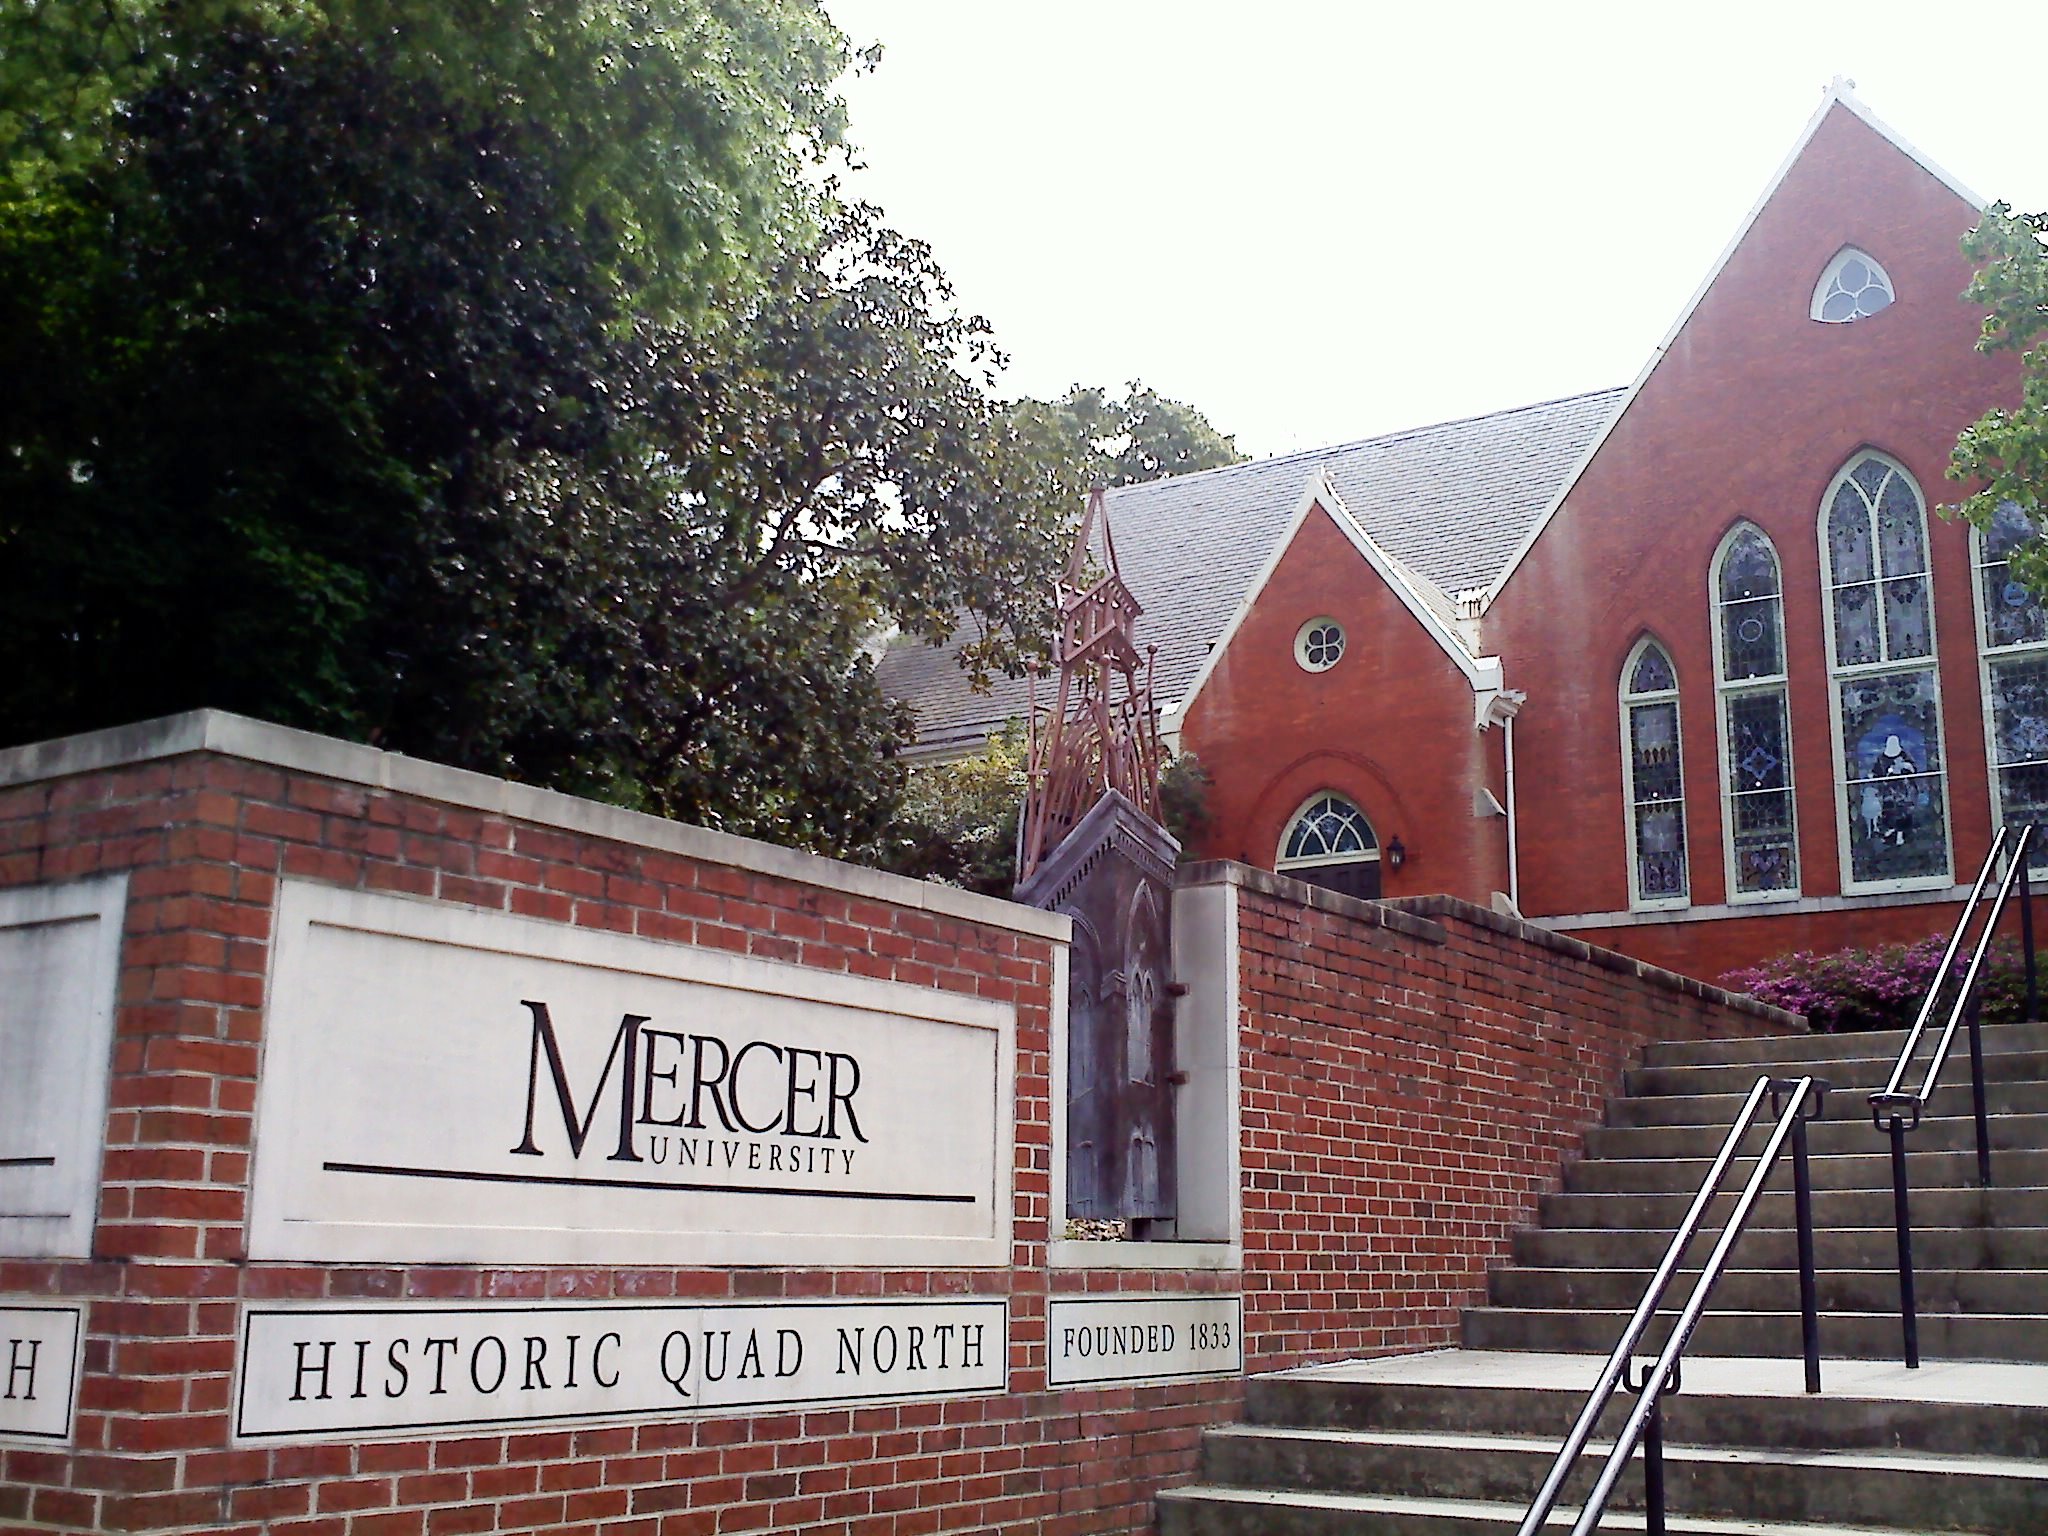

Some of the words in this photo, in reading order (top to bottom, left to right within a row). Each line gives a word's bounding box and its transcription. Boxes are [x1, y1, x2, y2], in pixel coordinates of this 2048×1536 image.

[509, 999, 869, 1162] MERCER
[649, 1135, 857, 1176] UNIVERSITY
[289, 1332, 624, 1402] HISTORIC
[660, 1328, 804, 1398] QUAD
[836, 1323, 986, 1376] NORTH
[1063, 1324, 1175, 1358] FOUNDED
[1189, 1322, 1231, 1351] 1833
